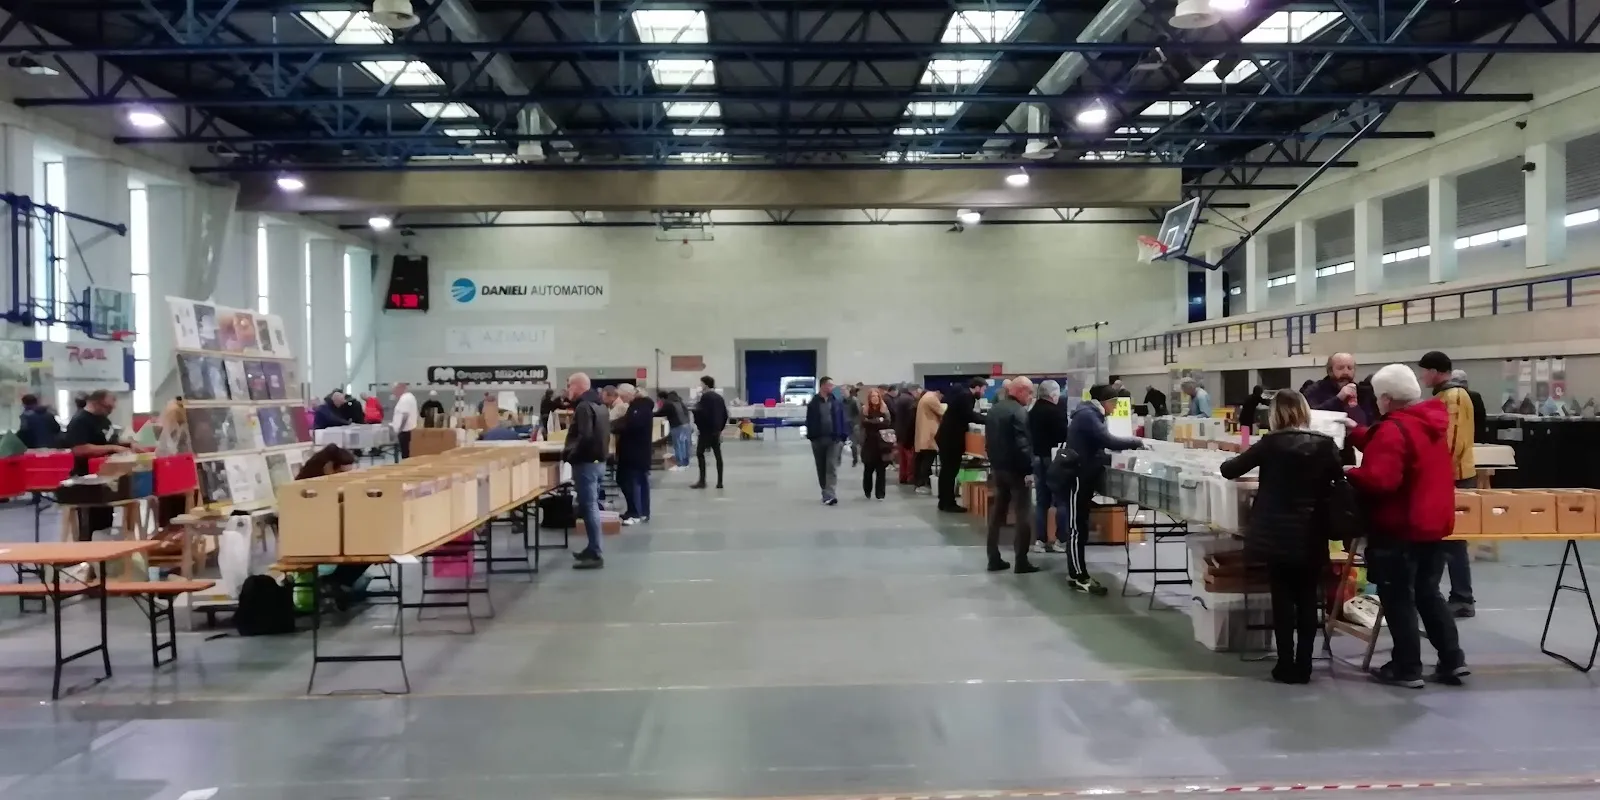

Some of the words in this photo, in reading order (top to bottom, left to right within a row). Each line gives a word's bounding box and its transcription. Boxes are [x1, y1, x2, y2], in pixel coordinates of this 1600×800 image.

[481, 285, 527, 296] DANIELI
[530, 285, 604, 296] AUTOMATION
[483, 329, 547, 343] AZIMUT
[456, 370, 493, 380] Gruppo
[494, 369, 545, 379] MIDOLINI
